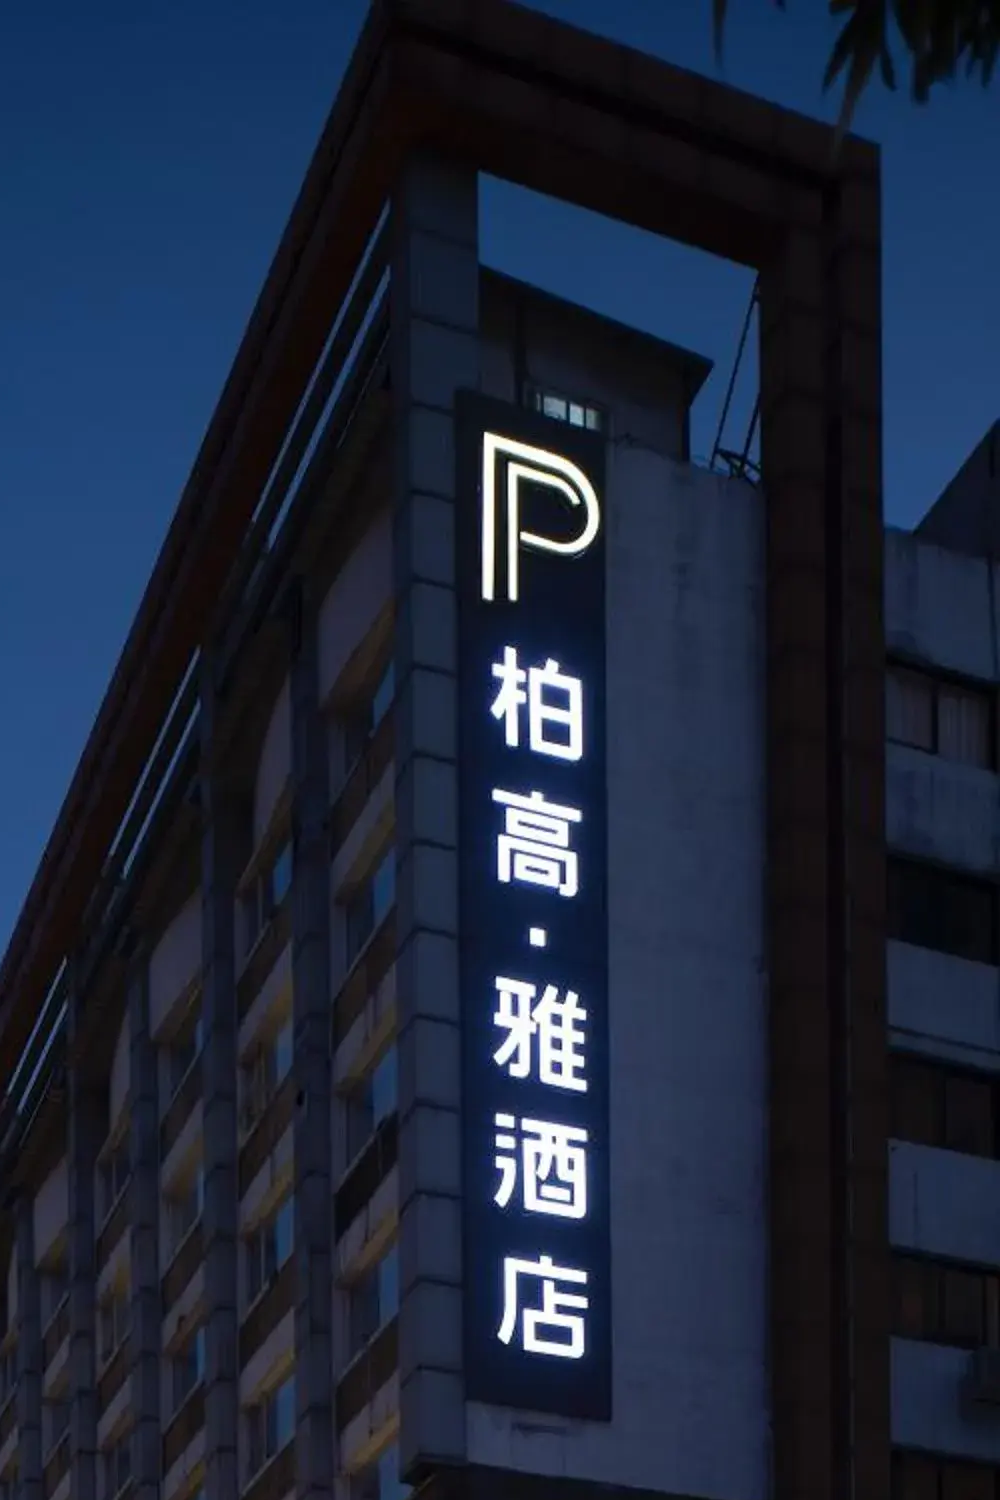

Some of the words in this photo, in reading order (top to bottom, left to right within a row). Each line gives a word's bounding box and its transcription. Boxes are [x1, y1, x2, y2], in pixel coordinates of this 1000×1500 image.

[490, 646, 589, 1361] 柏高·雅酒店
